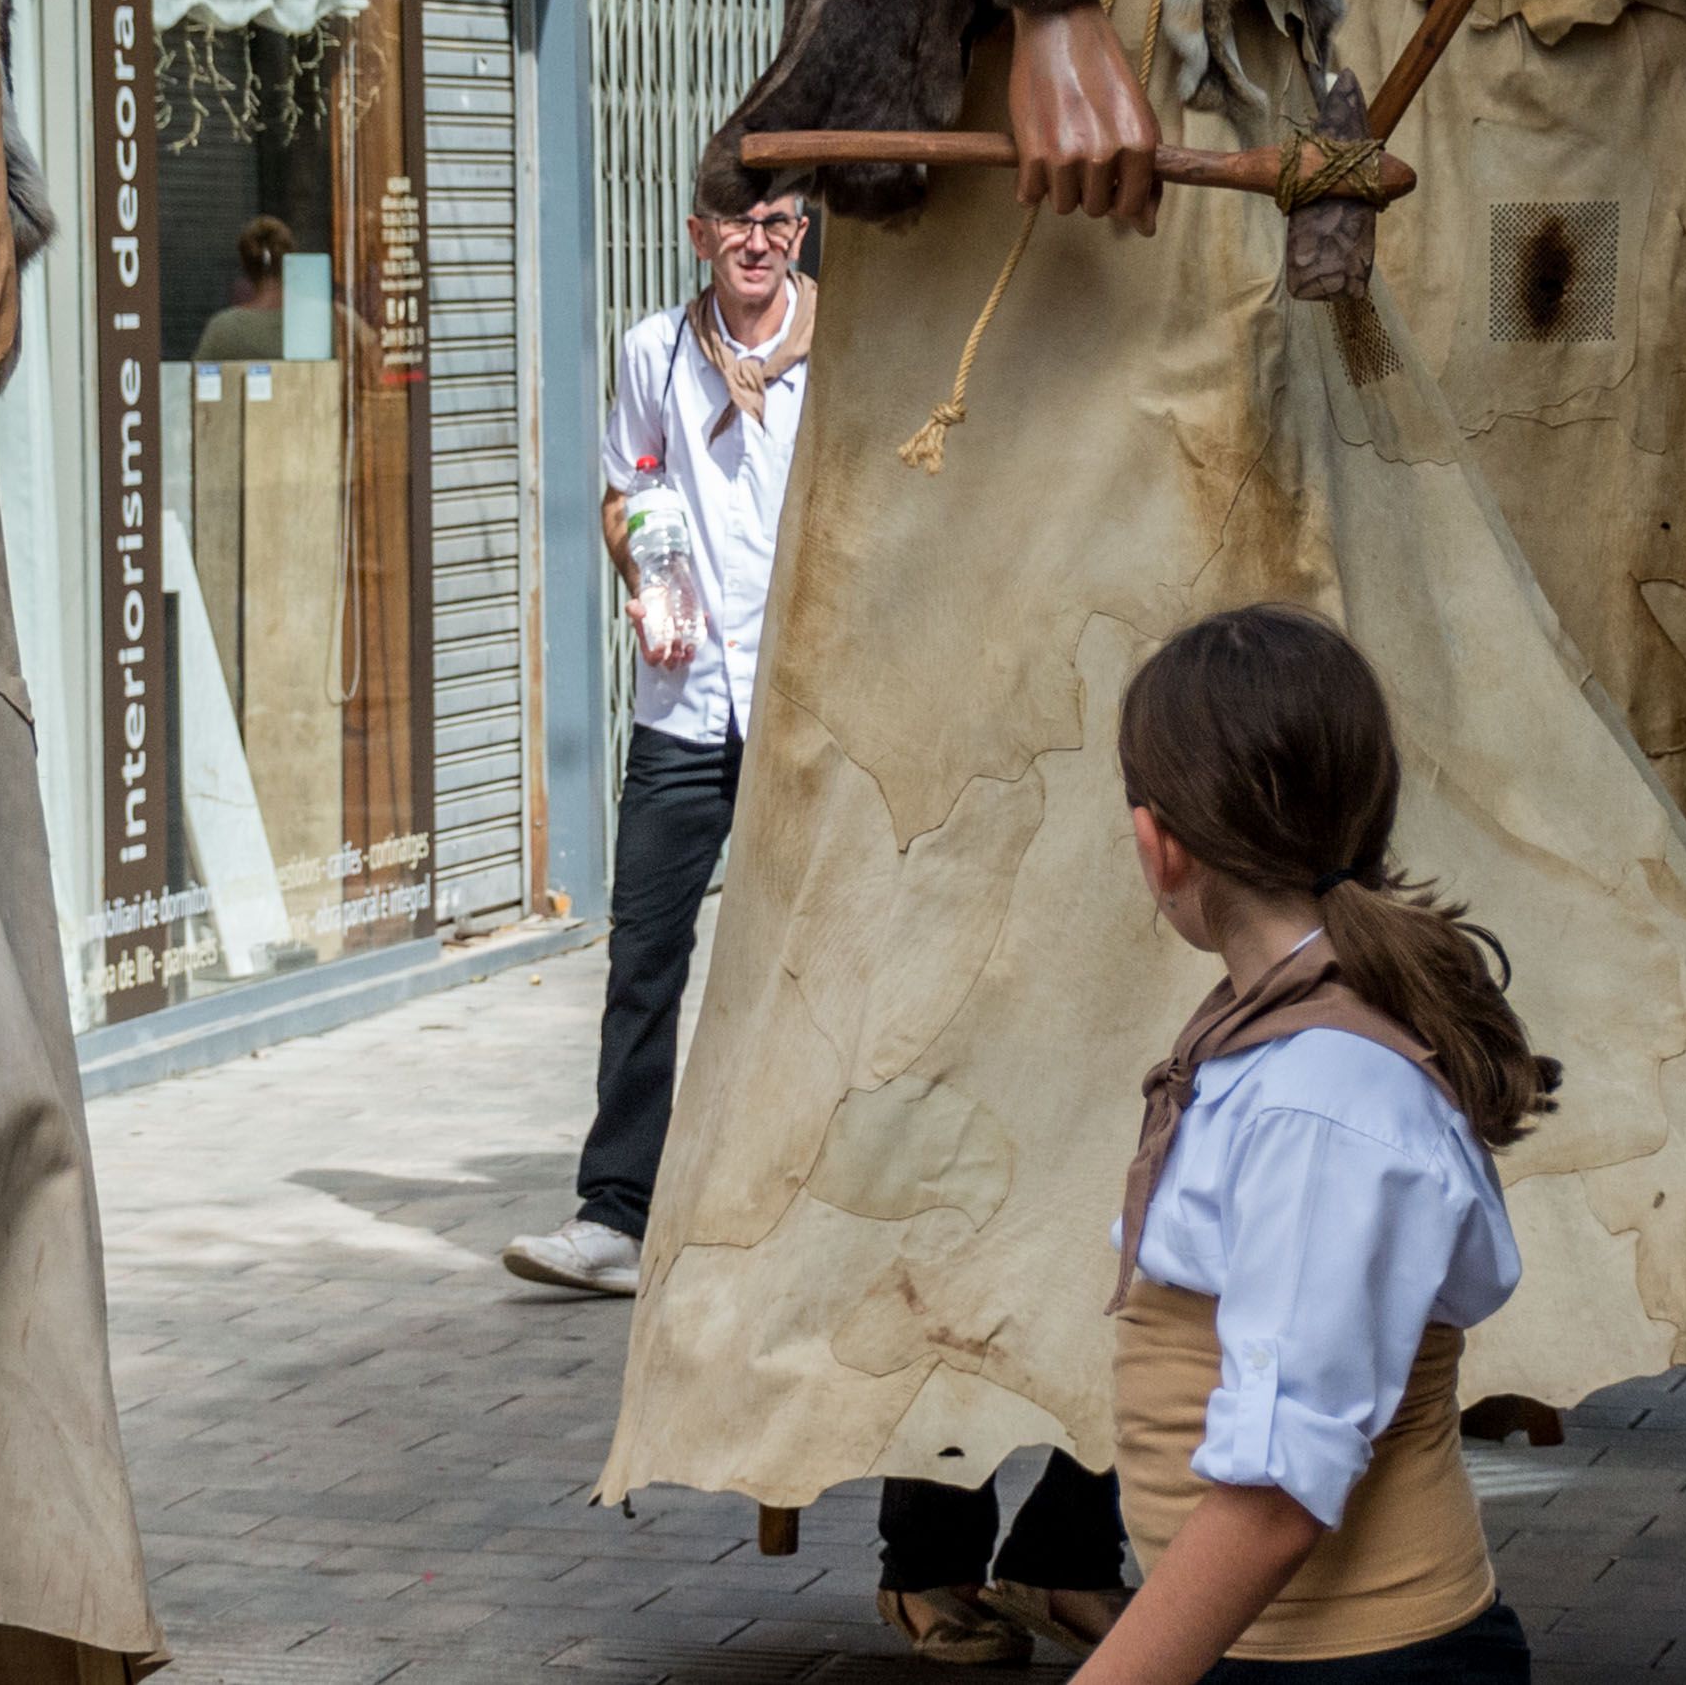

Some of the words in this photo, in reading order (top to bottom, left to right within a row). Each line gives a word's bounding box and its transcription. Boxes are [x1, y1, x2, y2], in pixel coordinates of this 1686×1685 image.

[114, 312, 142, 331] i
[117, 356, 148, 865] interiorisme
[117, 948, 137, 990] de
[136, 944, 155, 986] llit
[388, 872, 432, 922] integral
[142, 888, 159, 929] de
